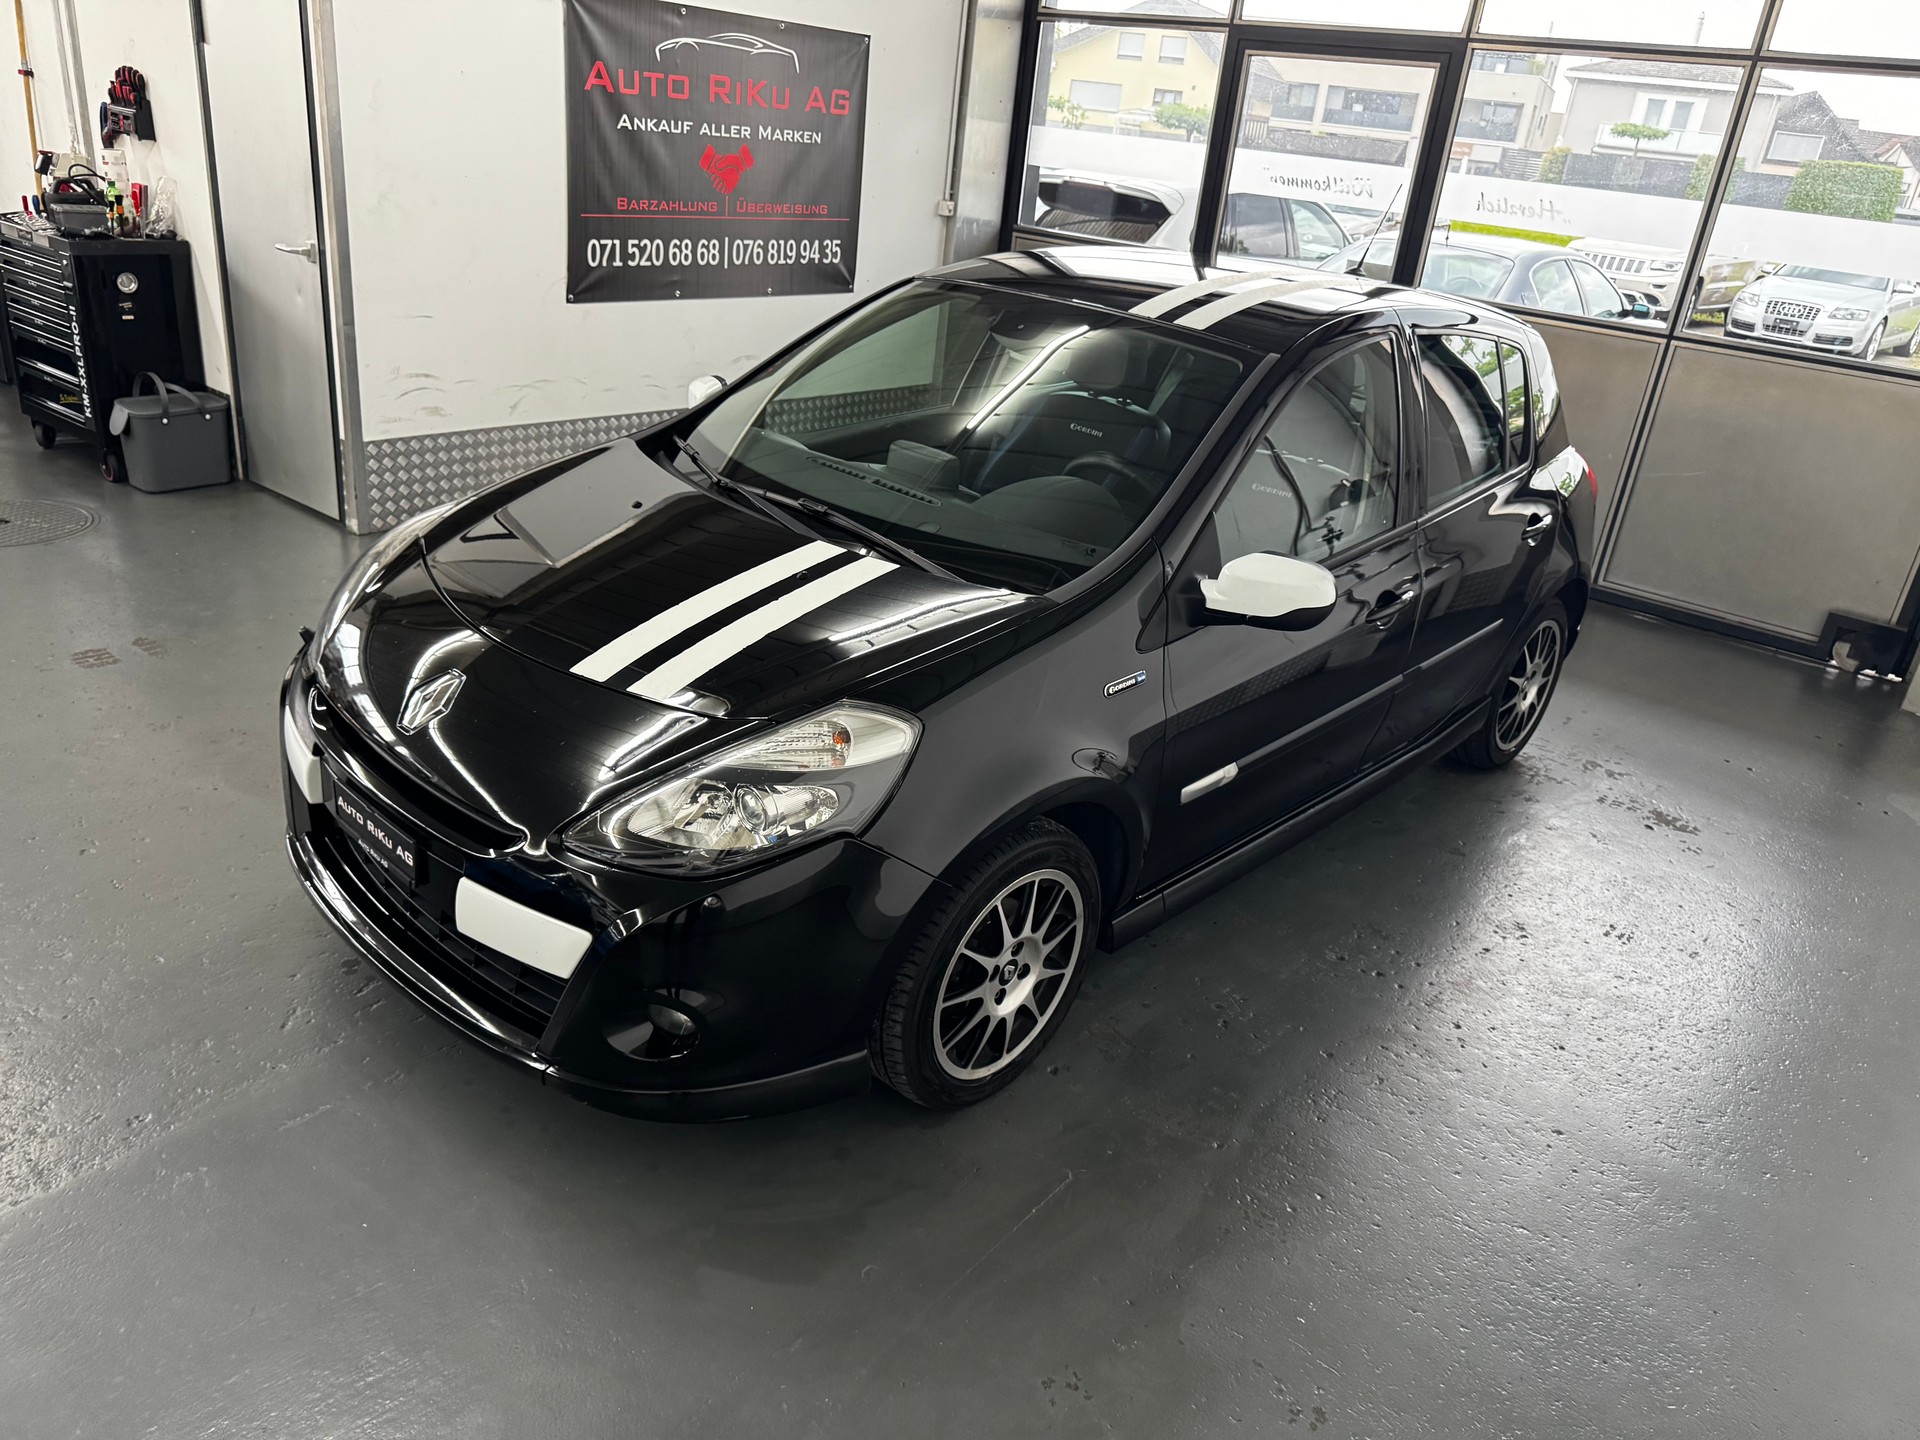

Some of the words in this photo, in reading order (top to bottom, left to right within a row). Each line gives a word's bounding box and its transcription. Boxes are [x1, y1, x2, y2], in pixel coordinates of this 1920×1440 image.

[804, 86, 850, 115] AG
[699, 122, 750, 139] ALLER
[587, 239, 623, 267] 071
[627, 239, 664, 267] 520
[668, 239, 692, 266] 68
[696, 238, 720, 266] 68
[732, 239, 763, 265] 076
[767, 239, 796, 265] 819
[800, 239, 820, 264] 94
[822, 239, 841, 264] 35
[338, 796, 364, 825] AUTO
[396, 845, 414, 867] AG
